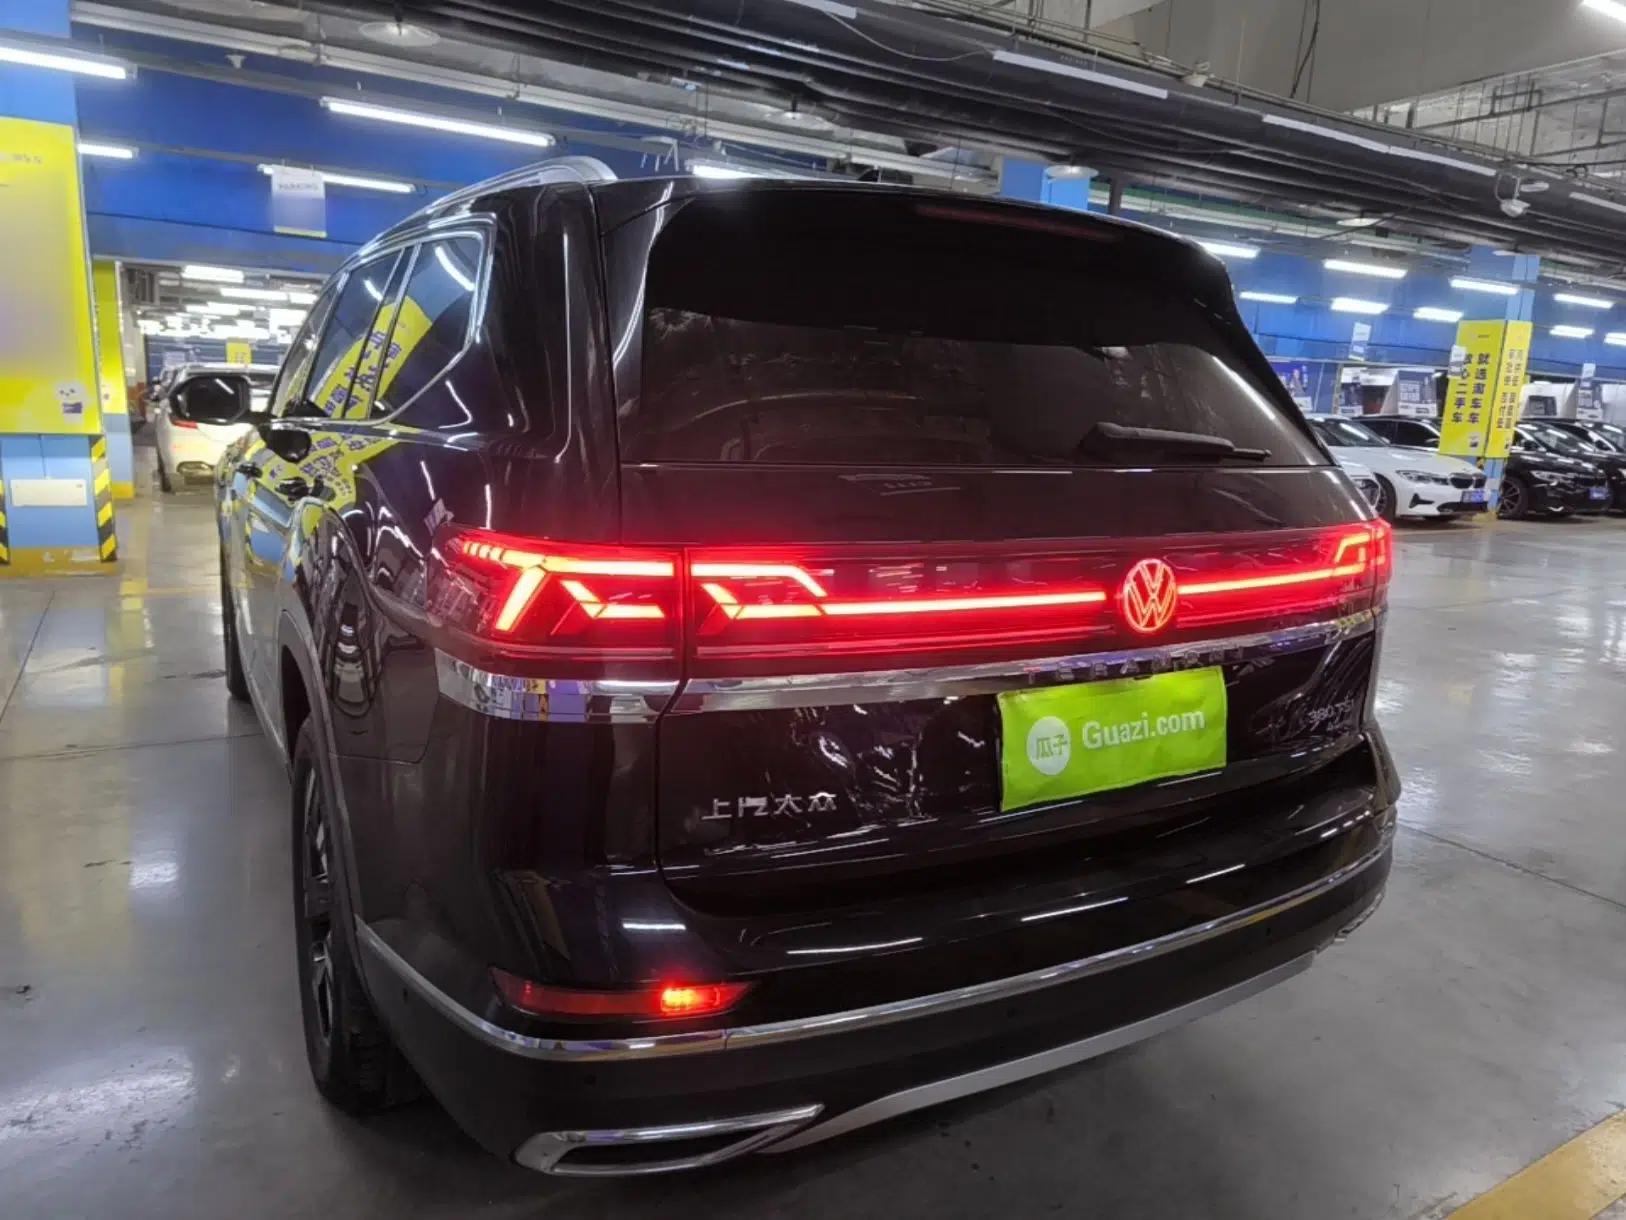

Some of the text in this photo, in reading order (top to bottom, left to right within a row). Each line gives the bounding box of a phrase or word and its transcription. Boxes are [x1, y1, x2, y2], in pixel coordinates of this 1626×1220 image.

[1082, 710, 1205, 749] Guazi.com
[1036, 734, 1067, 760] 瓜子
[701, 792, 837, 820] 上汽大众
